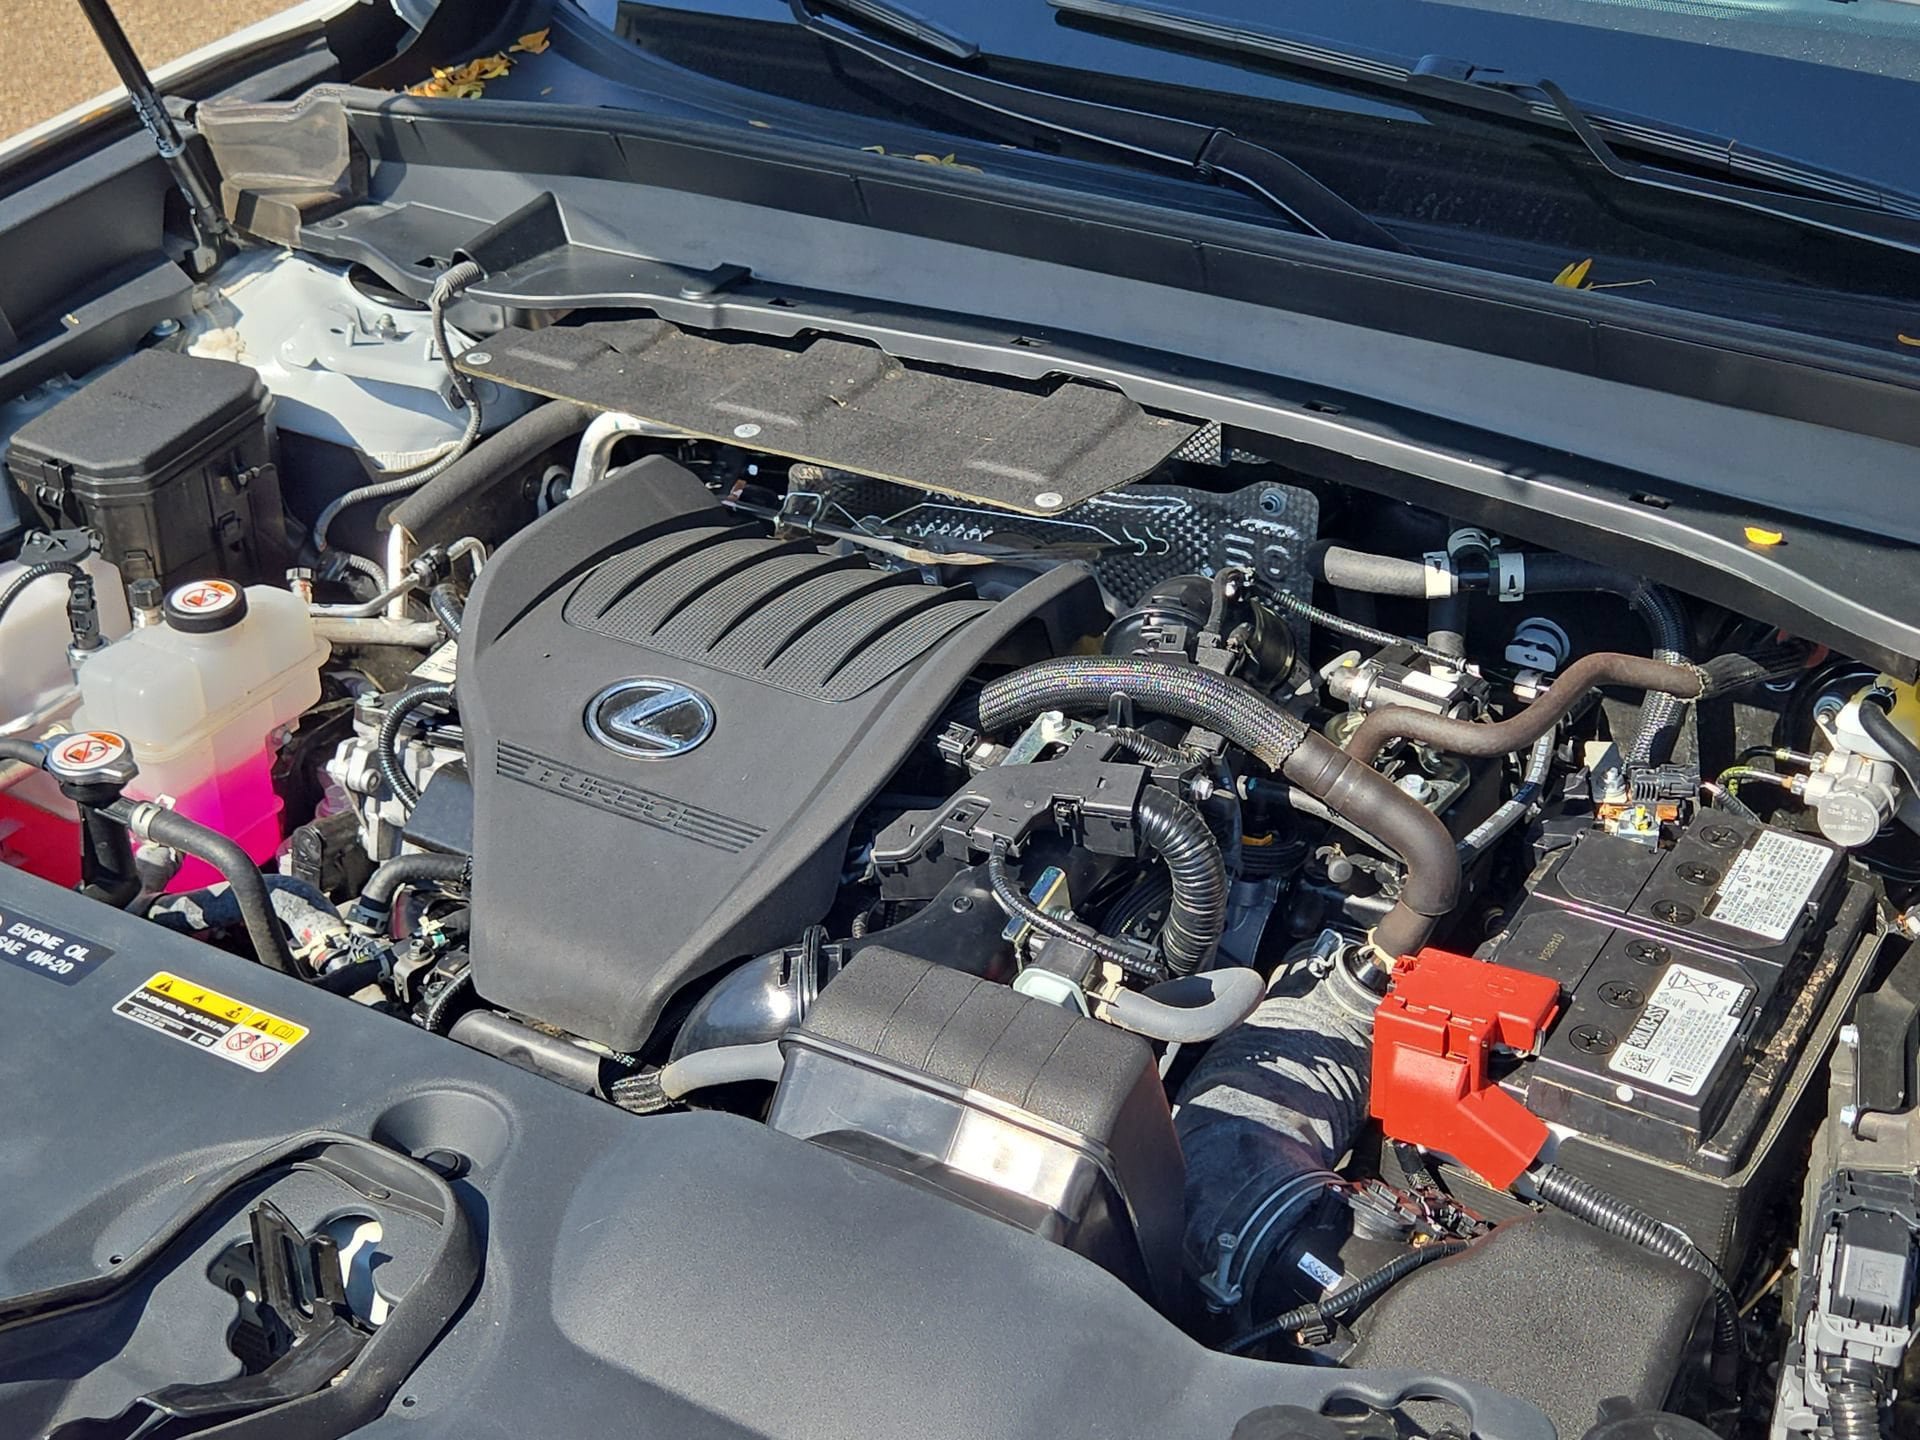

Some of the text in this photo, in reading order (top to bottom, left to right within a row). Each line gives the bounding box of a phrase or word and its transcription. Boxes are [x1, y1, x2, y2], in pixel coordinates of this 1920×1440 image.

[535, 761, 678, 823] TURBO
[0, 935, 75, 975] SAE 0W-20
[7, 922, 90, 962] ENGINE OIL
[1668, 1070, 1694, 1087] TN
